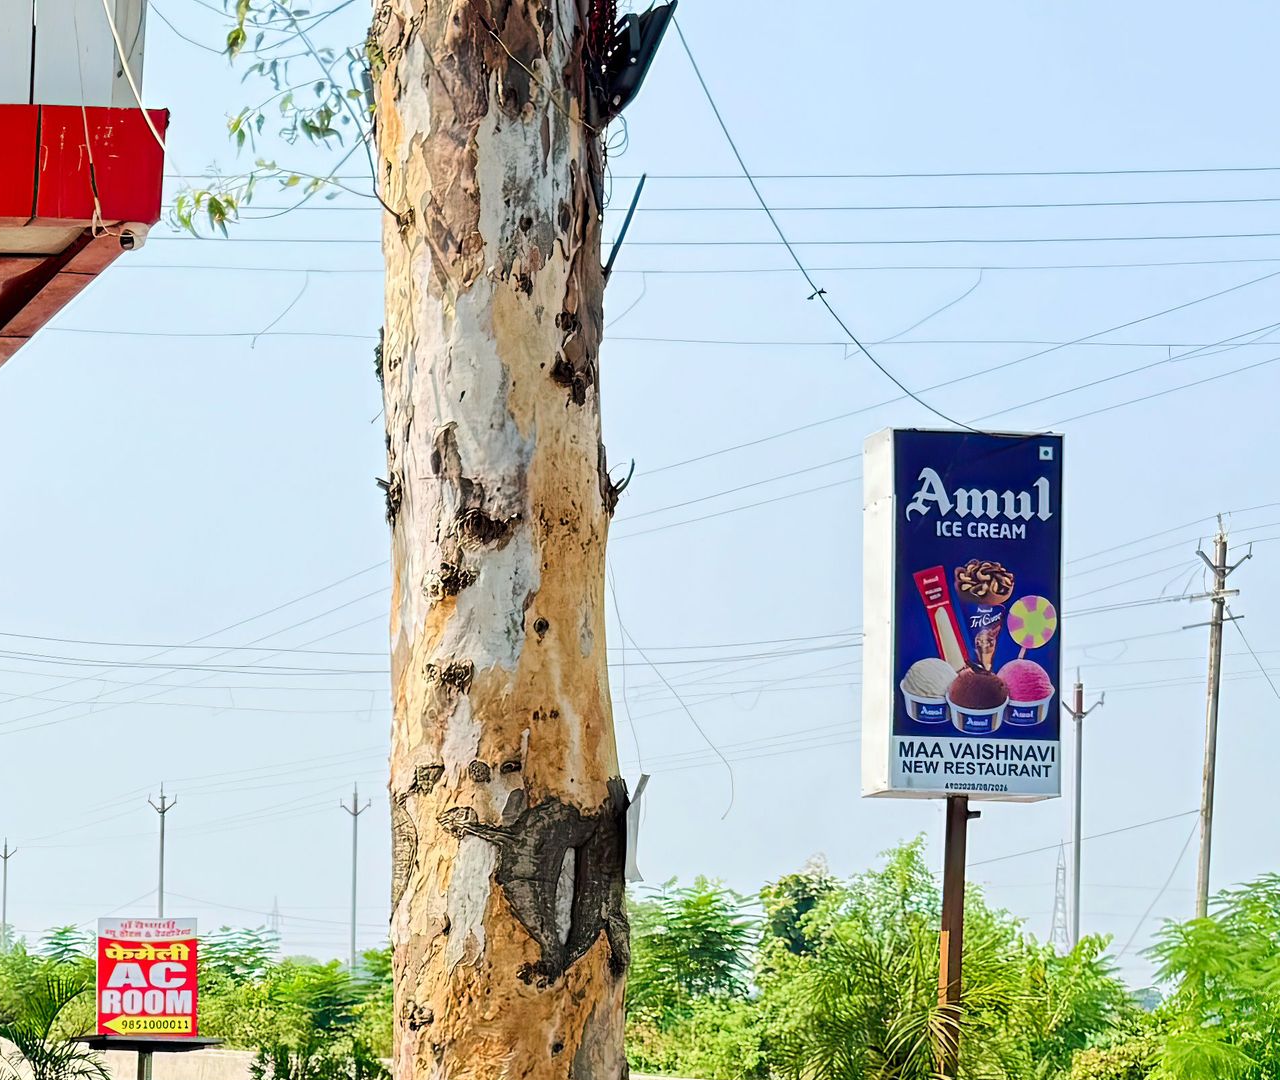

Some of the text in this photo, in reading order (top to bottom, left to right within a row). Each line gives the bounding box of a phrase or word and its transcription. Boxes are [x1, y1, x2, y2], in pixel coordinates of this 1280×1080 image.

[905, 467, 1054, 522] Amul
[936, 520, 1026, 540] ICE CREAM
[899, 741, 1055, 762] MAA VAISHNAVI
[902, 760, 1052, 778] NEW RESTAURANT
[106, 962, 188, 988] AC
[102, 989, 193, 1015] ROOM
